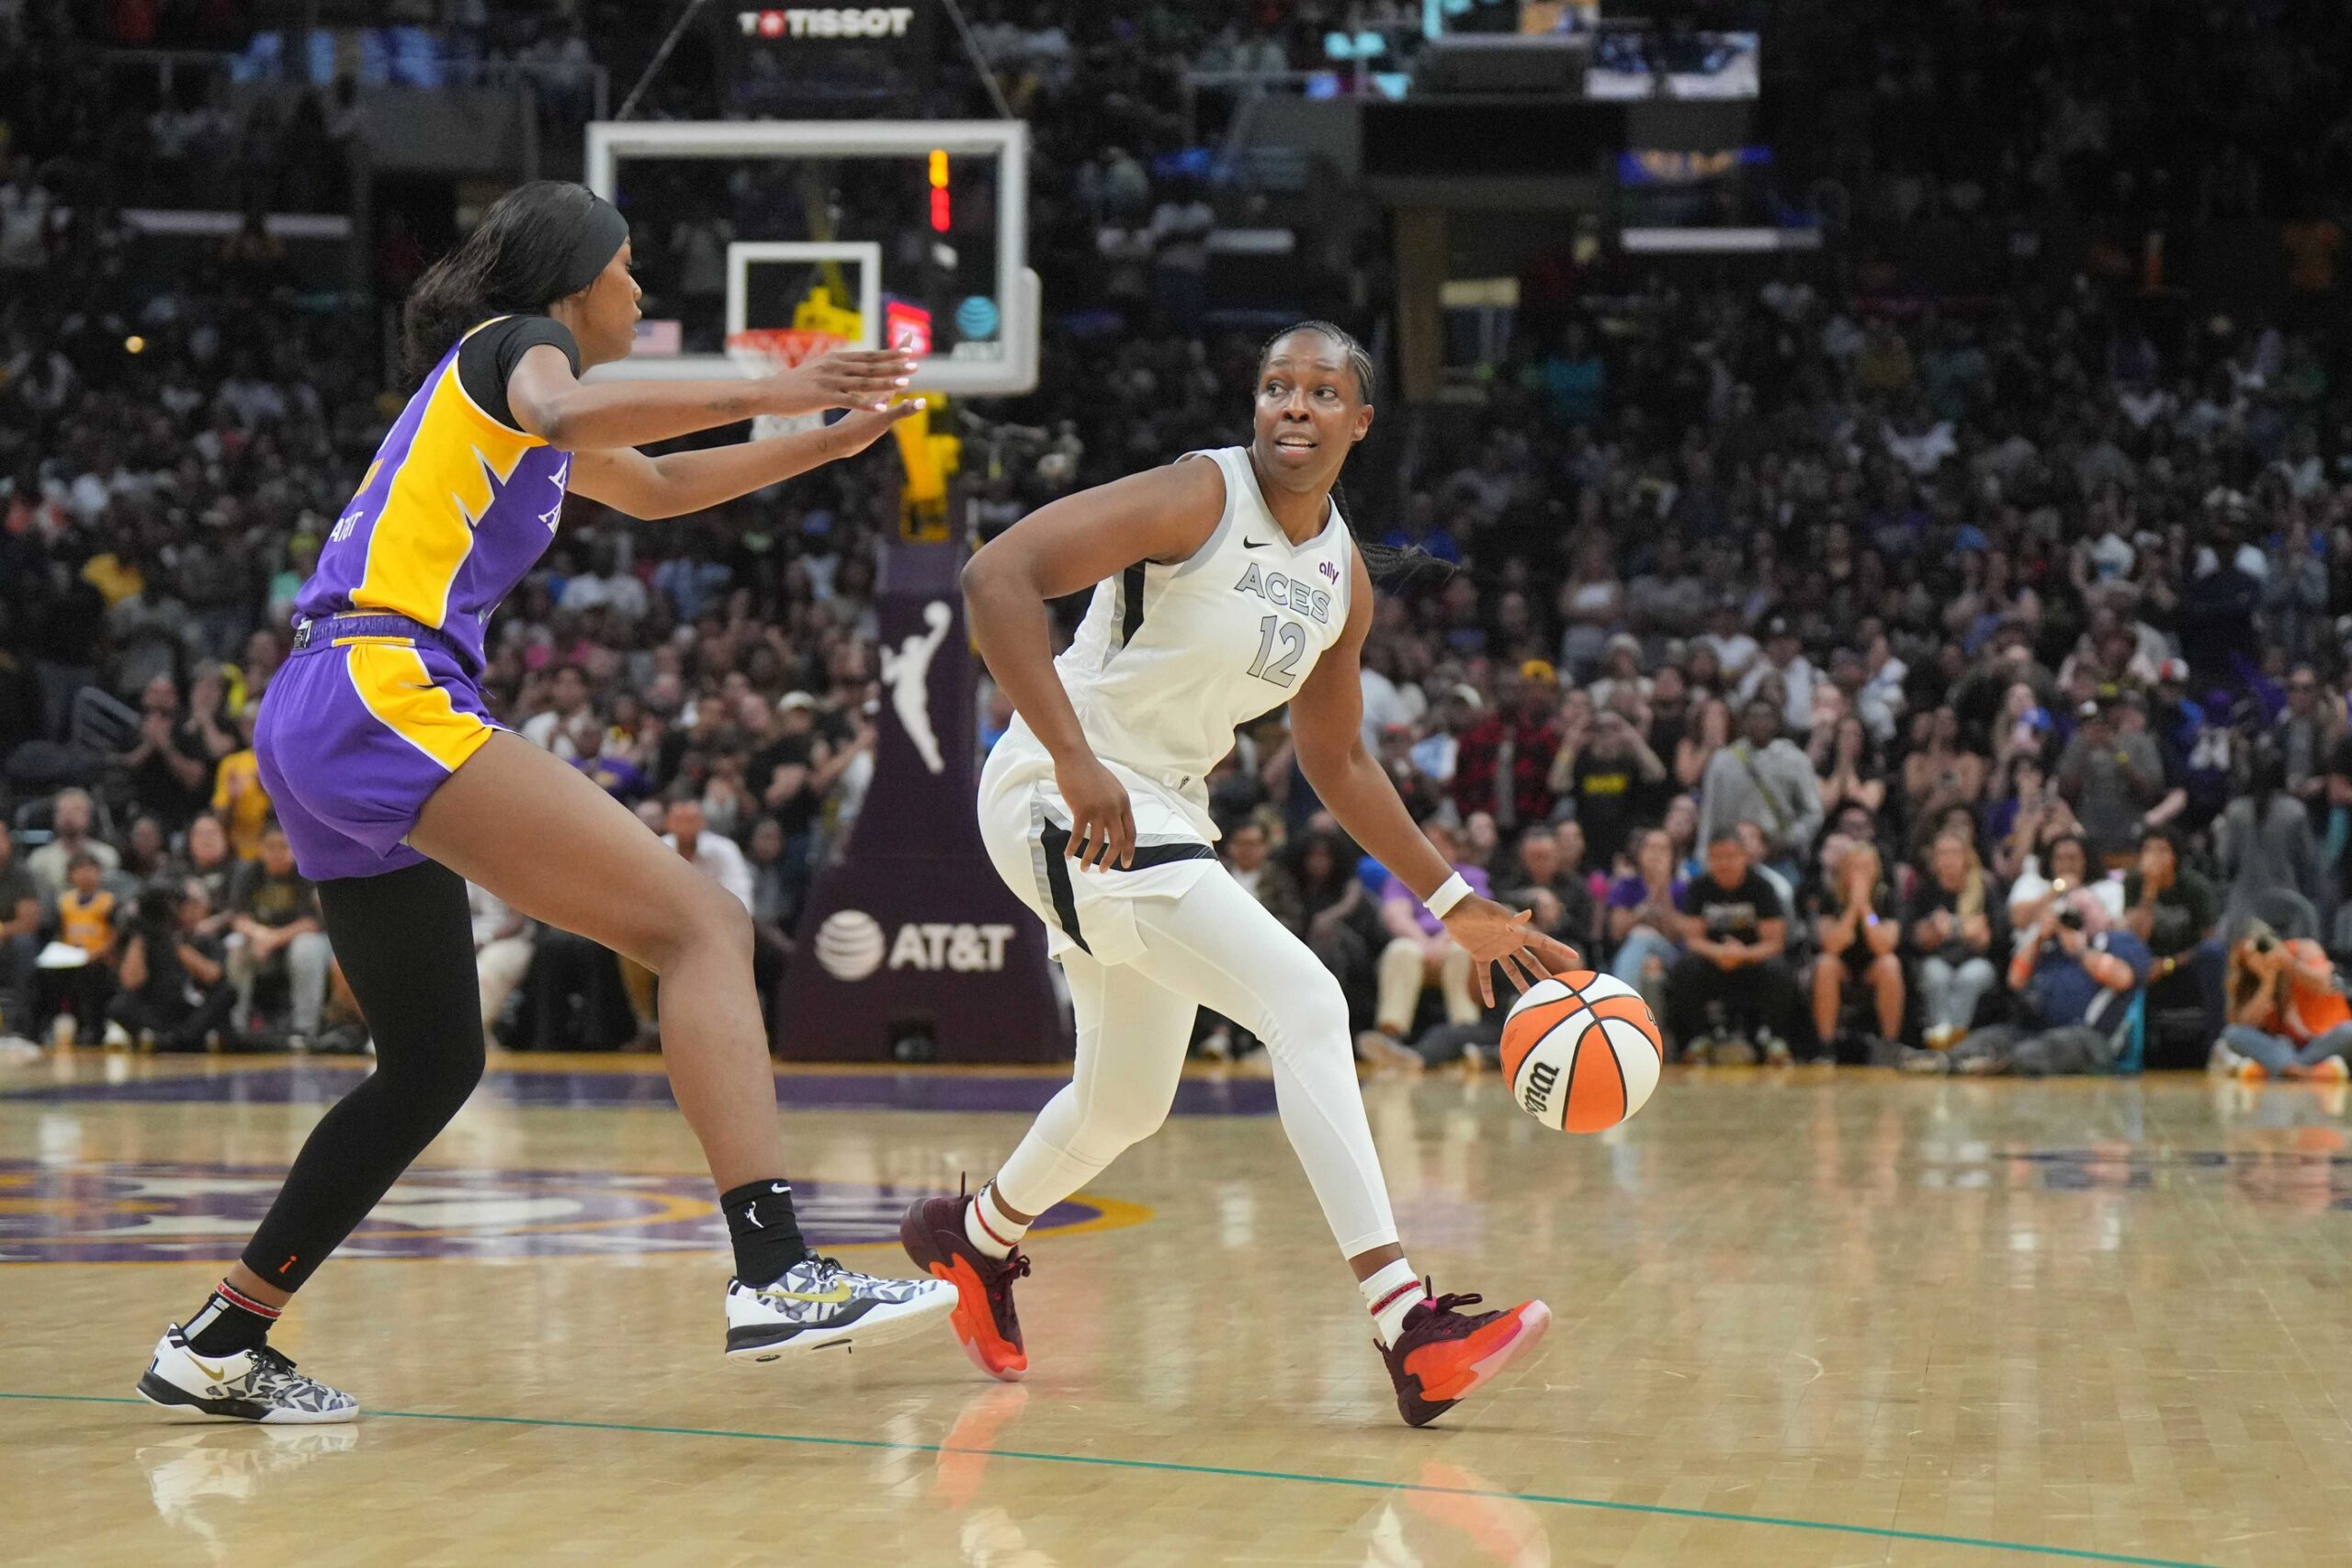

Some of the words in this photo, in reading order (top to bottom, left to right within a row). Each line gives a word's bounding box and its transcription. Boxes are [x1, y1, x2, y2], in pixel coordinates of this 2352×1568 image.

[786, 7, 913, 39] TISSOT
[1234, 561, 1331, 625] ACES
[1318, 560, 1340, 585] ally
[1246, 615, 1306, 689] 12
[888, 922, 1015, 972] AT&T
